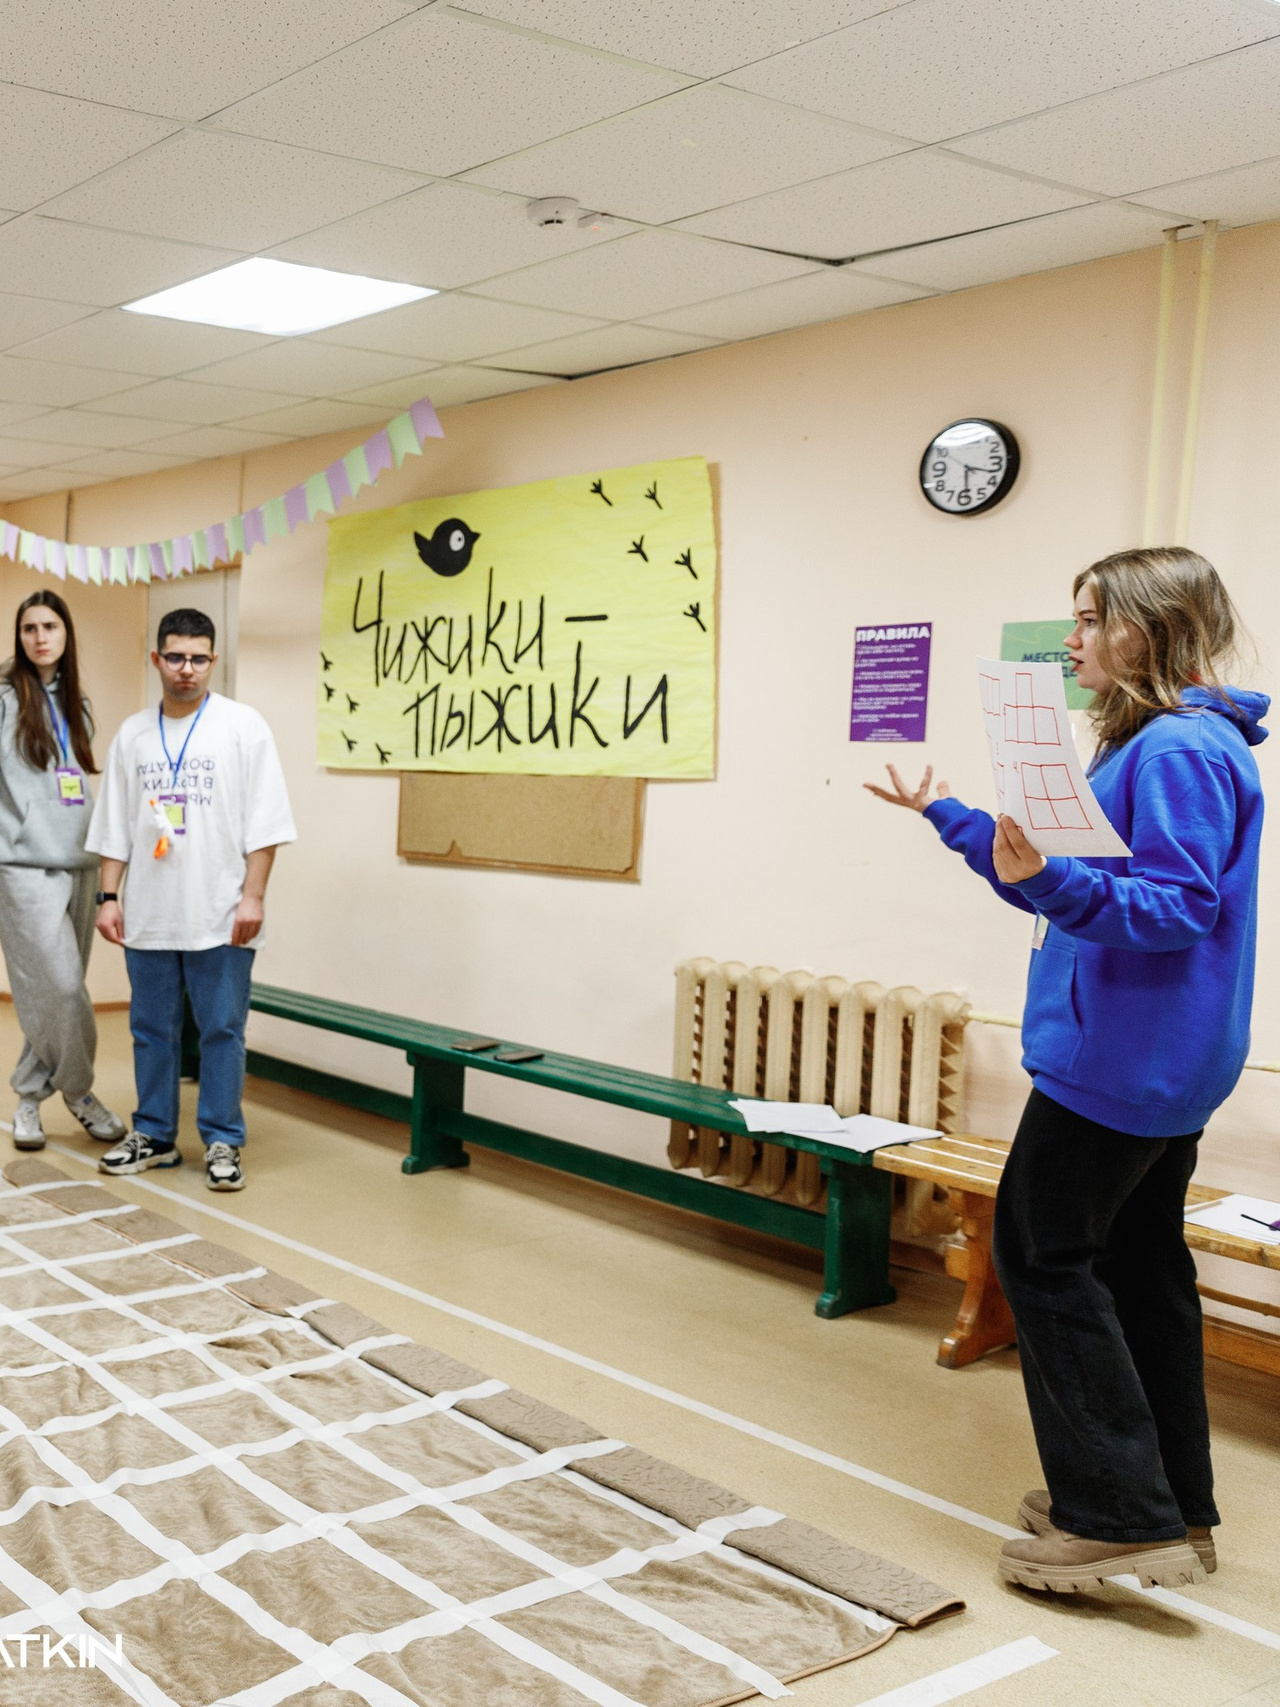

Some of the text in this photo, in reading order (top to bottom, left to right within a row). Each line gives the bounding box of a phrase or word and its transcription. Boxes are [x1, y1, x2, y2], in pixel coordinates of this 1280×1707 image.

[990, 441, 1000, 453] 2
[932, 461, 947, 478] 9
[989, 456, 1003, 473] 3
[935, 480, 945, 492] 8
[987, 475, 997, 487] 4
[945, 490, 955, 503] 7
[957, 489, 972, 506] 6
[976, 488, 986, 500] 5
[855, 626, 931, 643] ПРАВИЛА
